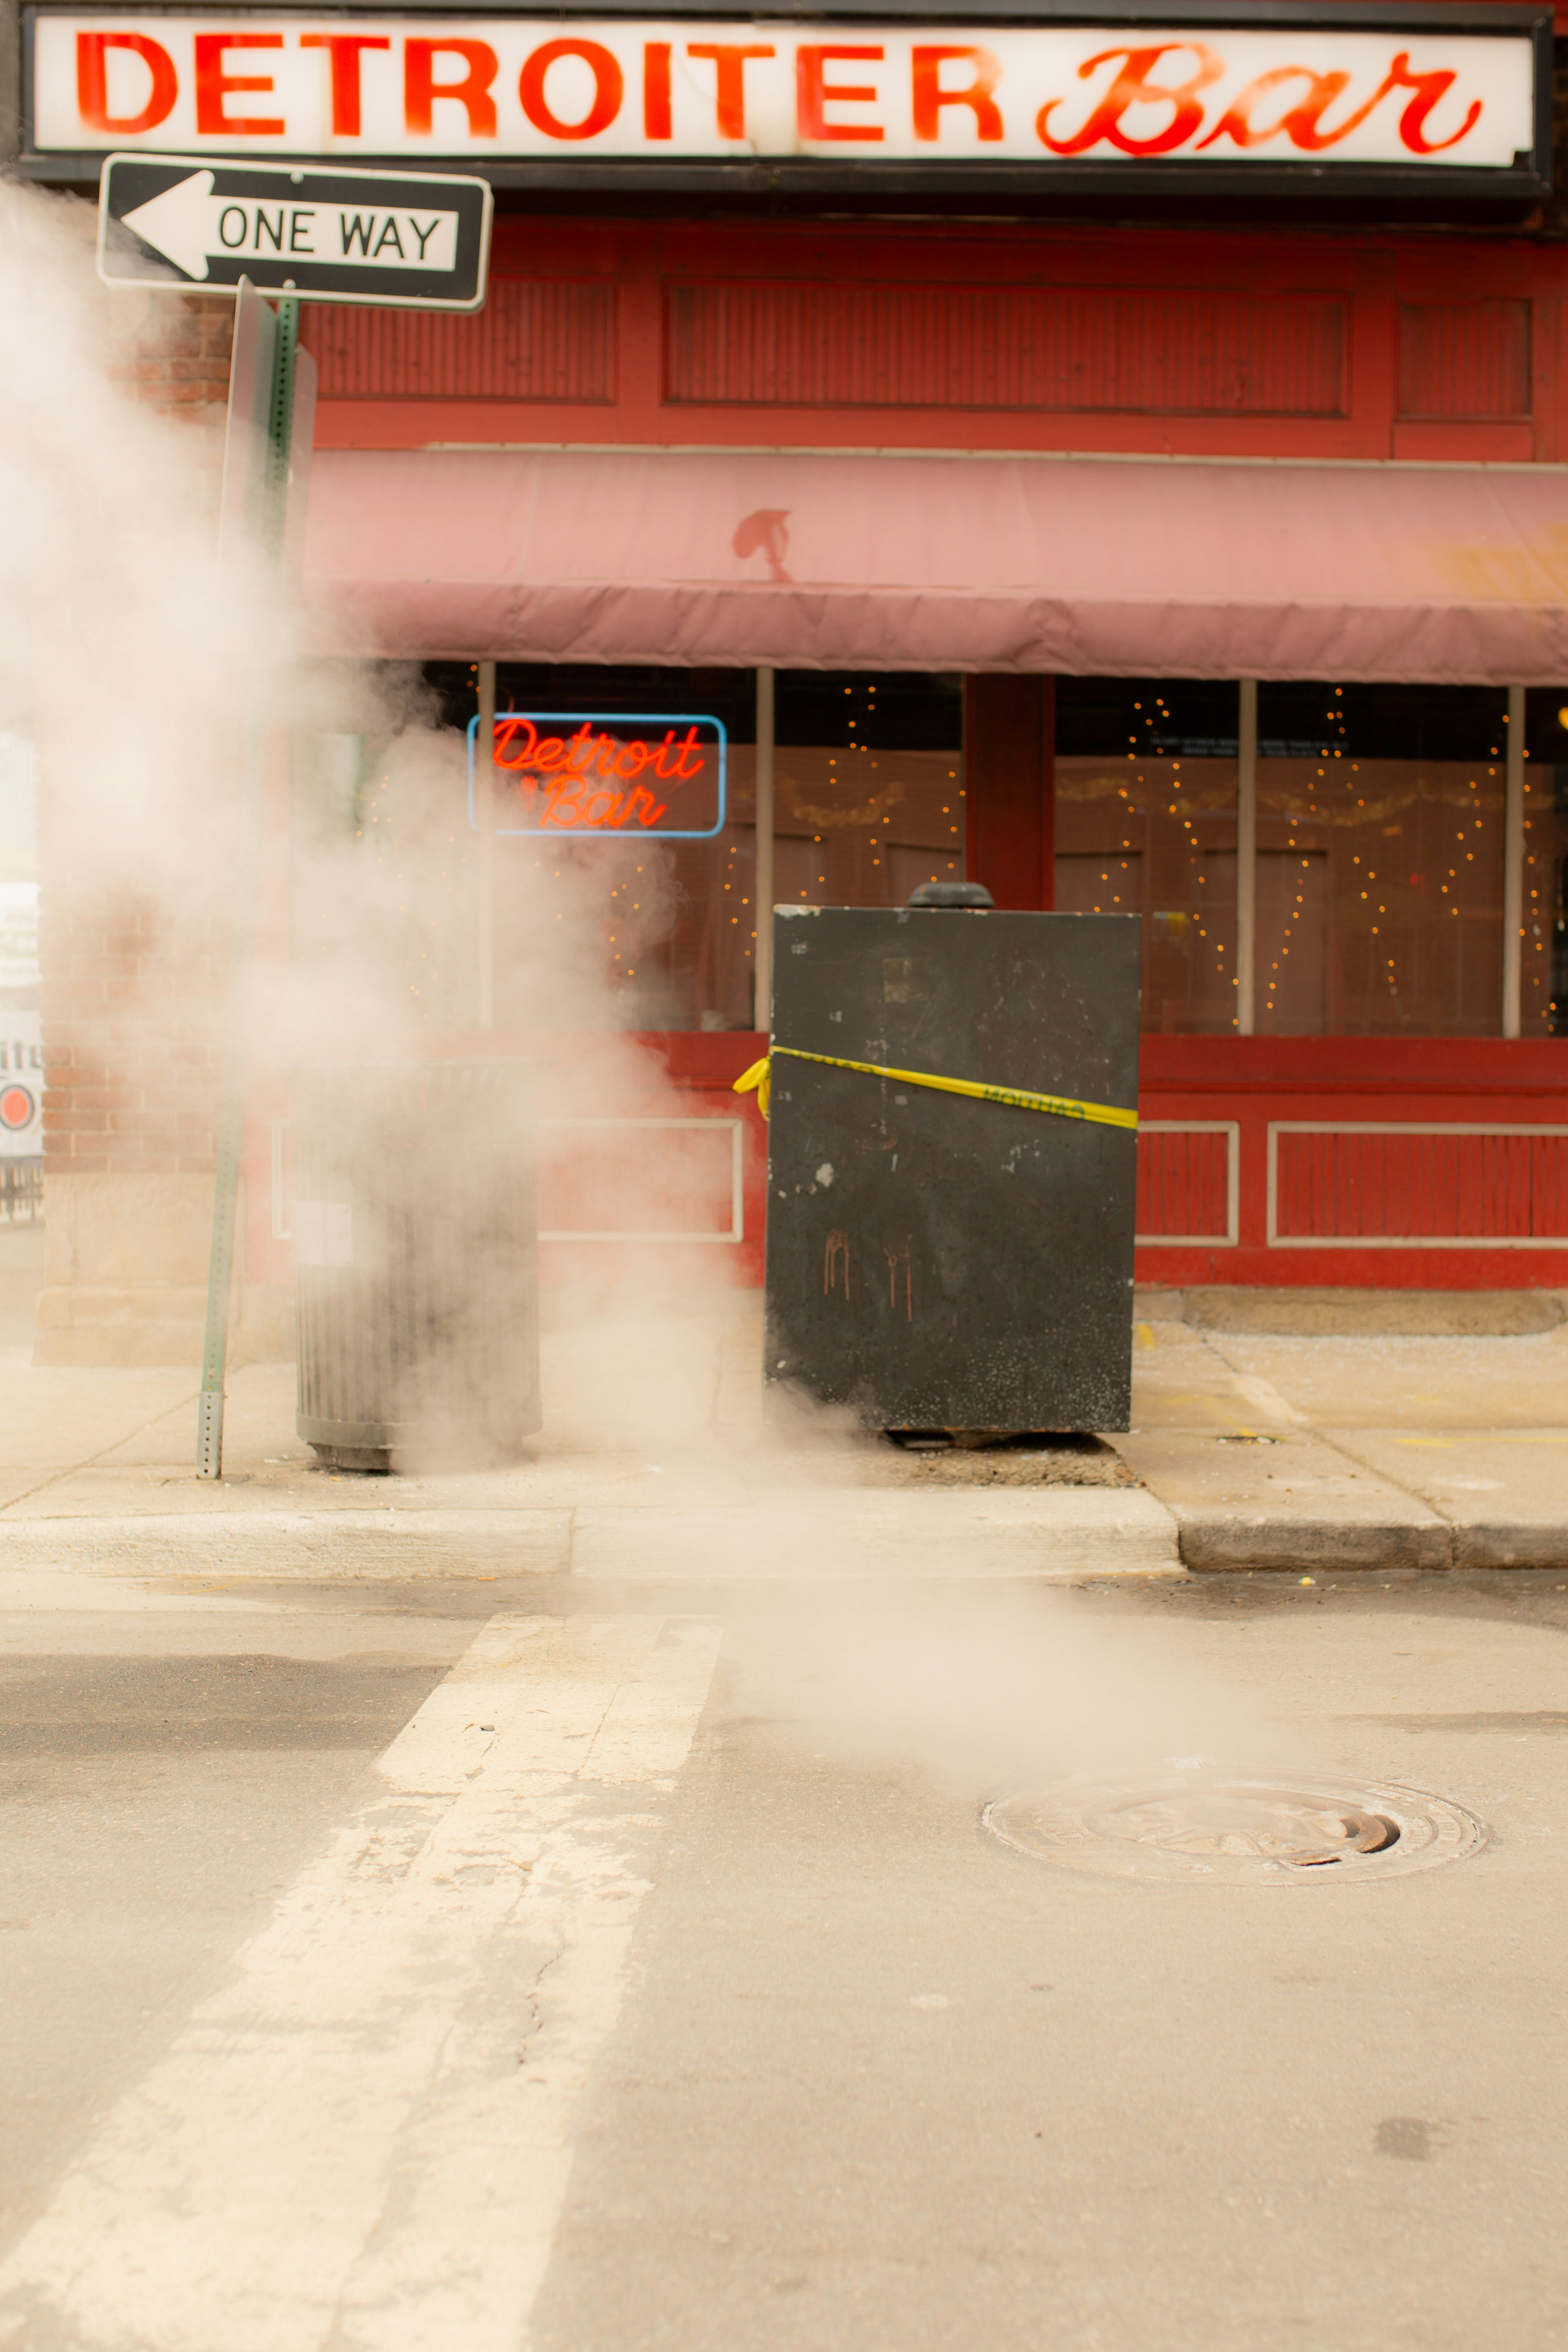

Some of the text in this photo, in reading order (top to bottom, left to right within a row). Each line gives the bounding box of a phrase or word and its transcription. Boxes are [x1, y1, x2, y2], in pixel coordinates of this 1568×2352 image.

[75, 31, 1483, 156] DETROITER Bar
[219, 205, 440, 261] ONE WAY
[492, 717, 705, 779] Detroit
[539, 773, 666, 827] Bar
